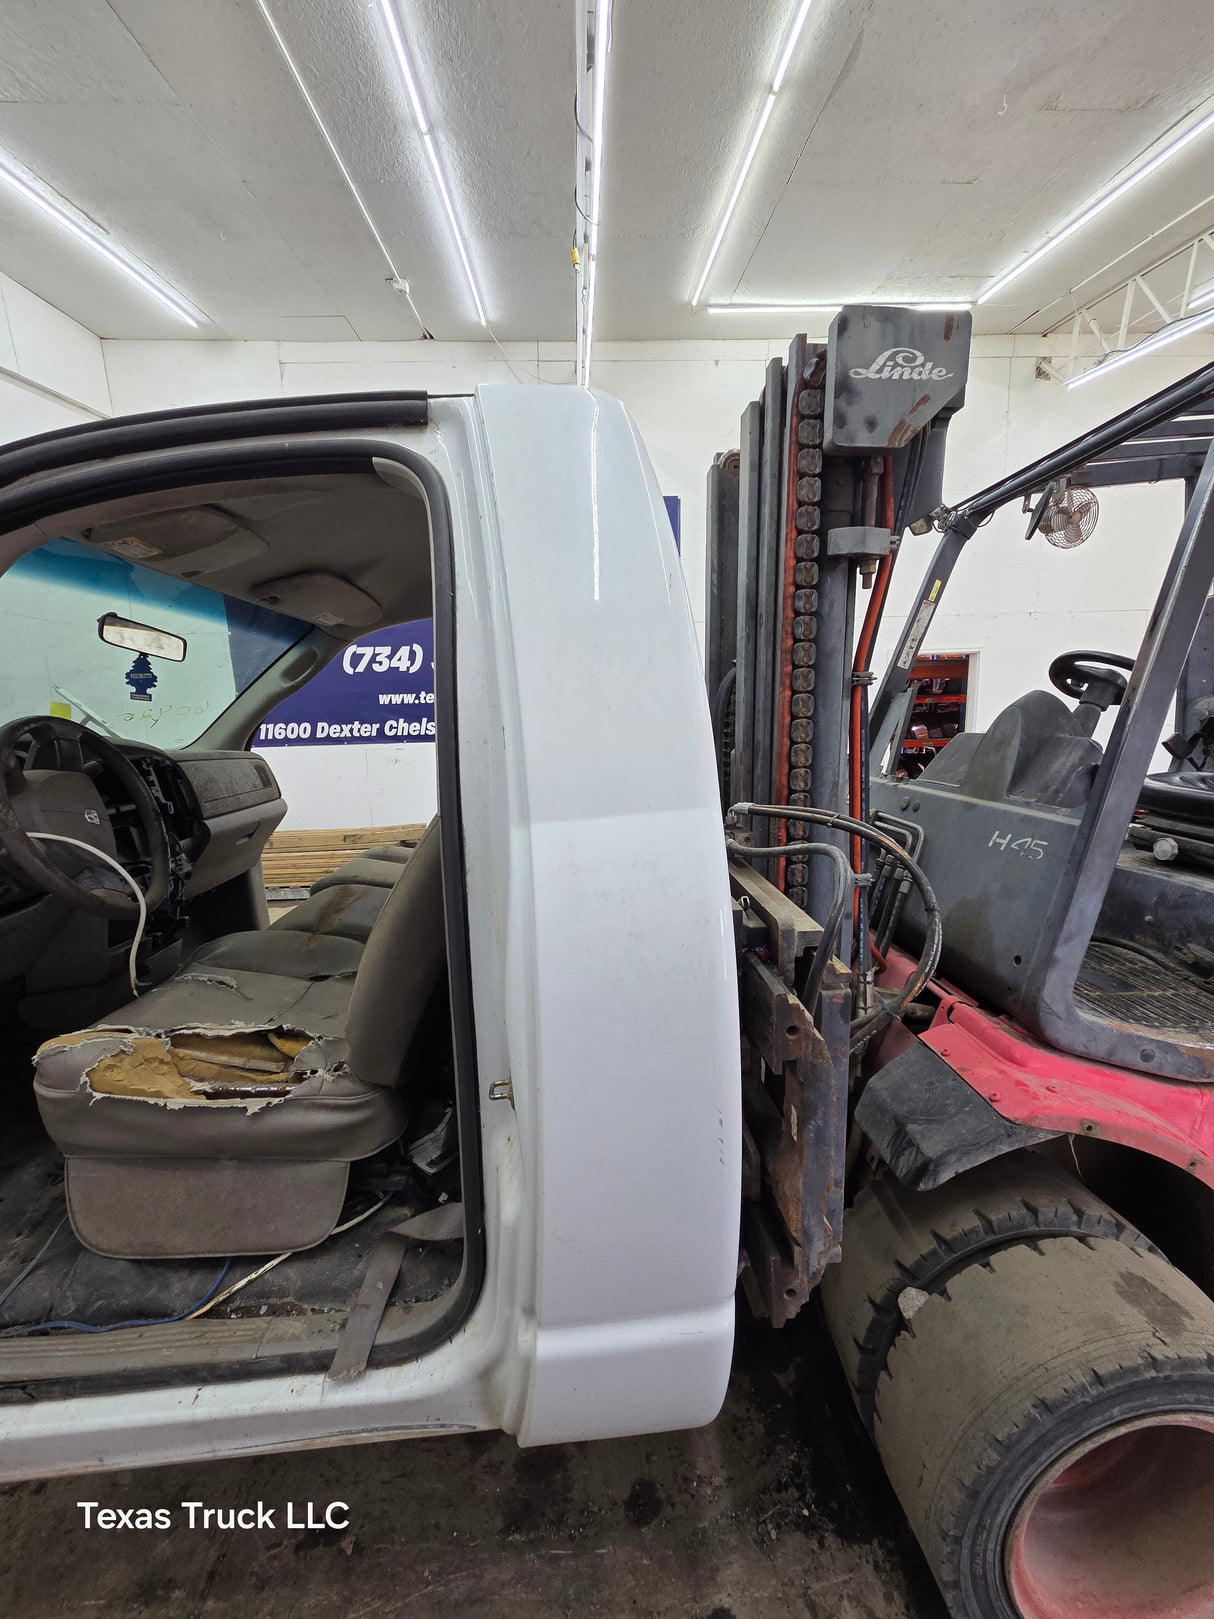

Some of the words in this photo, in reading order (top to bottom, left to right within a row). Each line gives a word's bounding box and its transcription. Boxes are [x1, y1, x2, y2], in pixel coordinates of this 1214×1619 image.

[849, 347, 954, 380] Linde
[342, 643, 424, 675] (734)
[259, 722, 312, 740] 11600
[316, 720, 380, 739] Dexter
[384, 717, 436, 736] Chels
[988, 830, 1049, 860] H45
